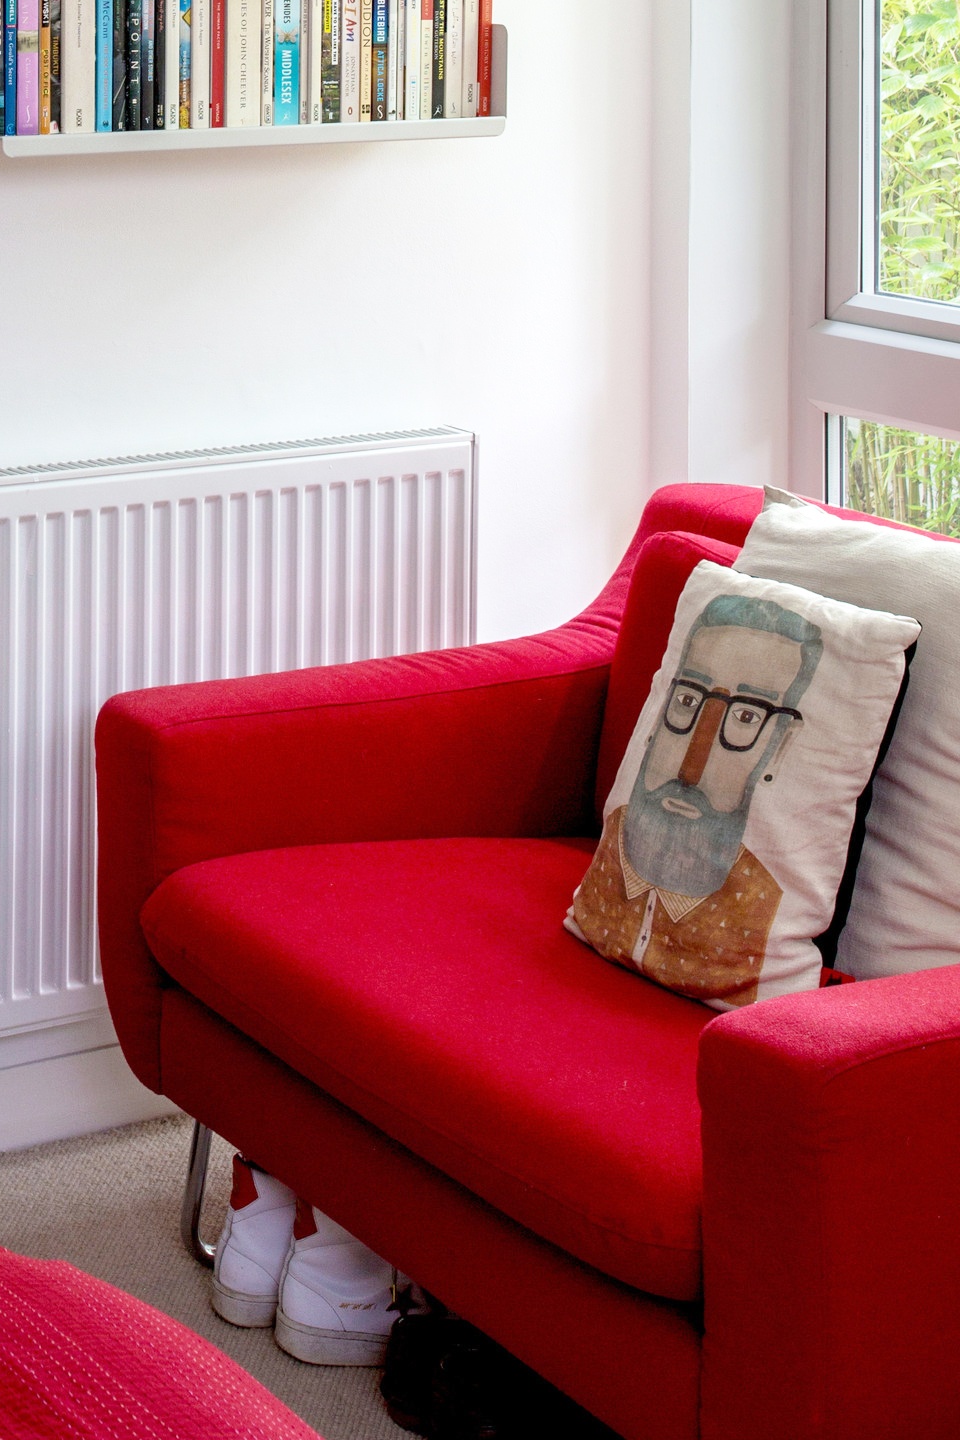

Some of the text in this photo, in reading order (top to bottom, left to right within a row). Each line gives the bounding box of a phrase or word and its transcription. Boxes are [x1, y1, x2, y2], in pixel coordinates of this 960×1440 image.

[377, 0, 385, 42] BLUEBIRD
[281, 50, 292, 104] MIDDLESEX
[376, 78, 384, 101] LOCKE
